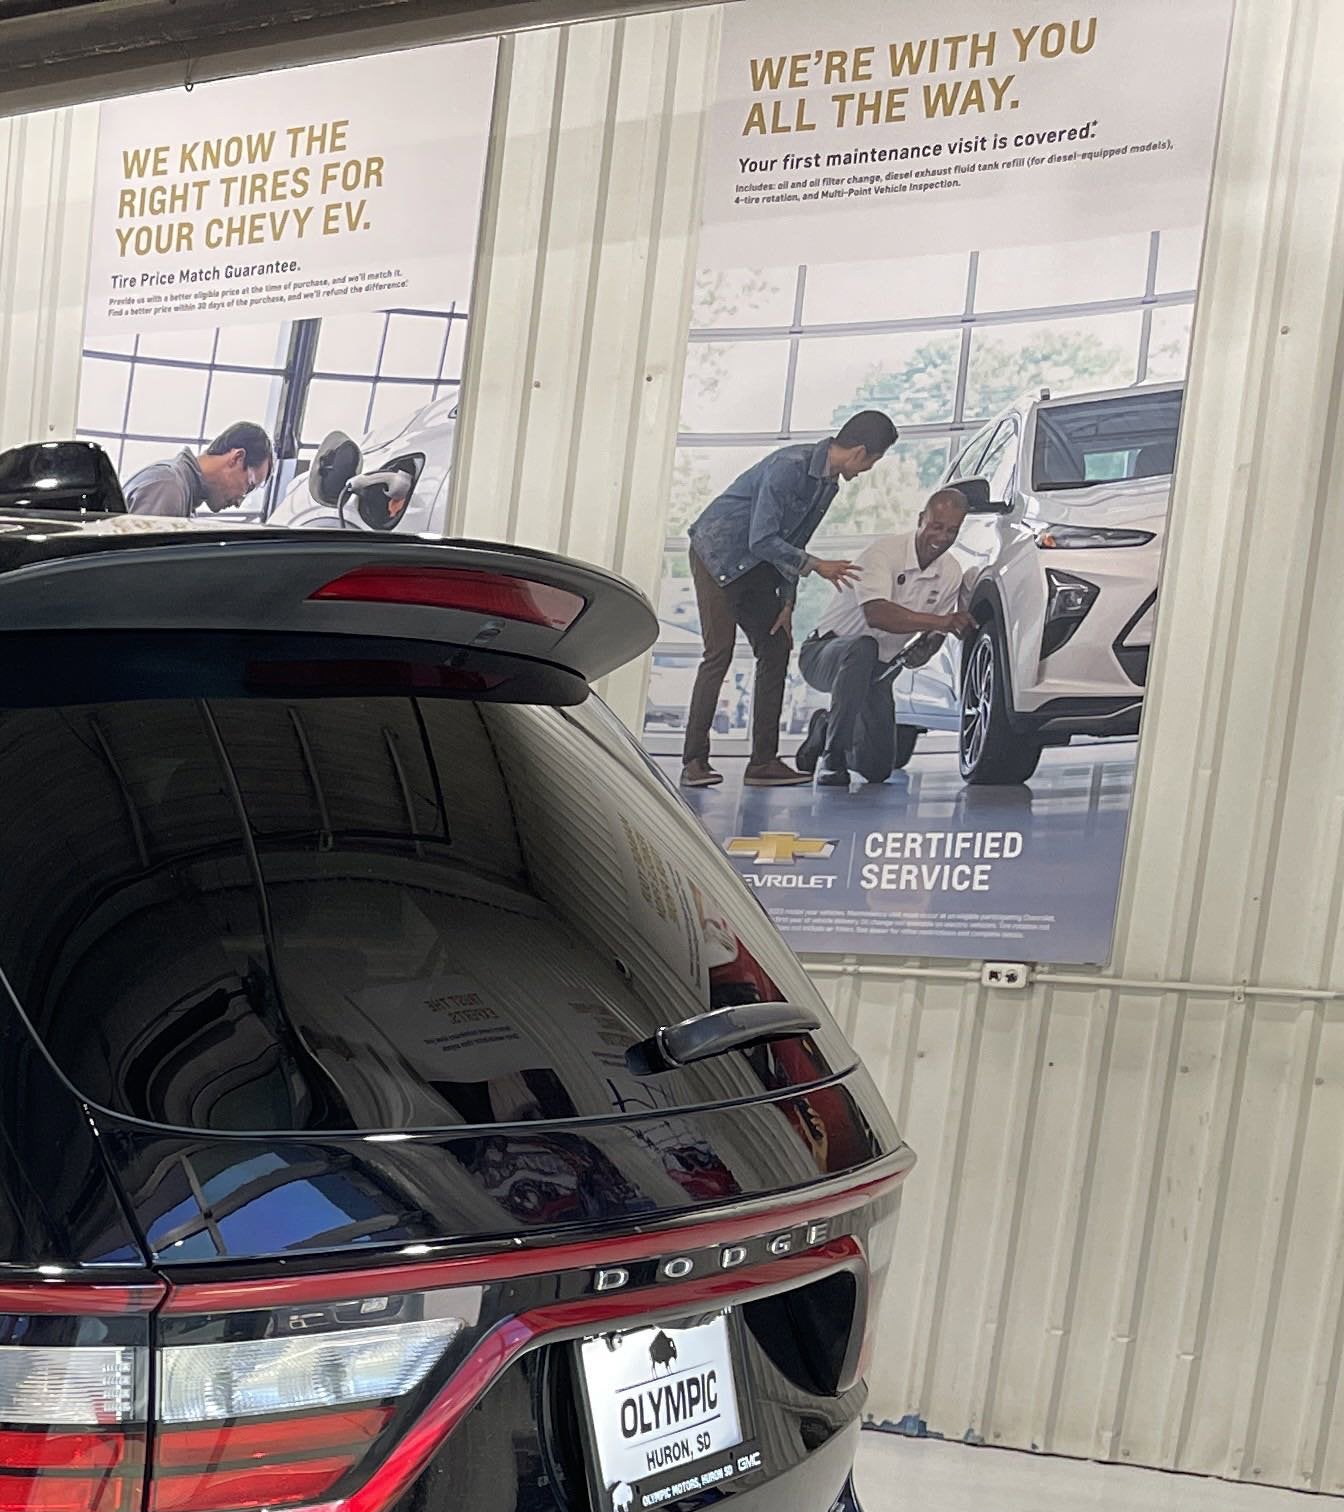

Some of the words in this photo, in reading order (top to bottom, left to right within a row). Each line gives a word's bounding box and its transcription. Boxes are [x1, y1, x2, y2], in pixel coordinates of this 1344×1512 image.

[749, 46, 876, 92] WE'RE
[889, 31, 997, 77] WITH
[1013, 17, 1098, 62] YOU
[742, 99, 817, 136] ALL
[832, 87, 909, 128] THE
[922, 74, 1021, 118] WAY.
[122, 146, 170, 180] WE
[179, 131, 276, 173] KNOW
[286, 119, 350, 158] THE
[736, 183, 776, 193] Includes:
[777, 181, 789, 190] oil
[790, 179, 807, 188] and
[809, 178, 820, 187] oil
[822, 176, 845, 186] filter
[847, 173, 883, 185] change,
[885, 170, 913, 181] diesel
[915, 167, 952, 178] exhaust
[954, 163, 976, 174] fluid
[978, 160, 999, 171] tank
[1002, 157, 1025, 168] refill
[1027, 155, 1046, 168] (for
[1047, 145, 1128, 165] diesel-equipped
[1130, 138, 1174, 154] models),
[739, 158, 777, 173] Your
[783, 154, 820, 170] first
[826, 144, 942, 167] maintenance
[948, 136, 987, 154] visit
[992, 133, 1007, 150] is
[118, 180, 210, 218] RIGHT
[219, 166, 310, 208] TIRES
[320, 156, 385, 195] FOR
[734, 195, 760, 205] 4-tire
[762, 193, 800, 203] rotation,
[802, 191, 819, 200] and
[821, 187, 872, 200] Multi-Point
[874, 183, 907, 195] Vehicle
[909, 178, 961, 193] Inspection.
[115, 222, 194, 258] YOUR
[205, 206, 315, 249] CHEVY
[322, 199, 372, 236] EV.
[111, 274, 137, 289] Tire
[140, 272, 175, 287] Price
[179, 266, 220, 284] Match
[224, 260, 301, 279] Guarantee.
[221, 286, 240, 297] price
[251, 284, 263, 294] the
[332, 274, 346, 285] and
[287, 292, 301, 301] and
[350, 284, 363, 294] the
[864, 831, 1023, 859] CERTIFIED
[742, 874, 837, 889] EVROLET
[860, 863, 992, 891] SERVICE
[597, 1223, 828, 1291] DODGE
[620, 1369, 717, 1439] OLYMPIC
[646, 1439, 694, 1471] HURON,
[697, 1431, 711, 1453] SD
[641, 1486, 672, 1507] OLYMPIC
[737, 1451, 761, 1471] GMC
